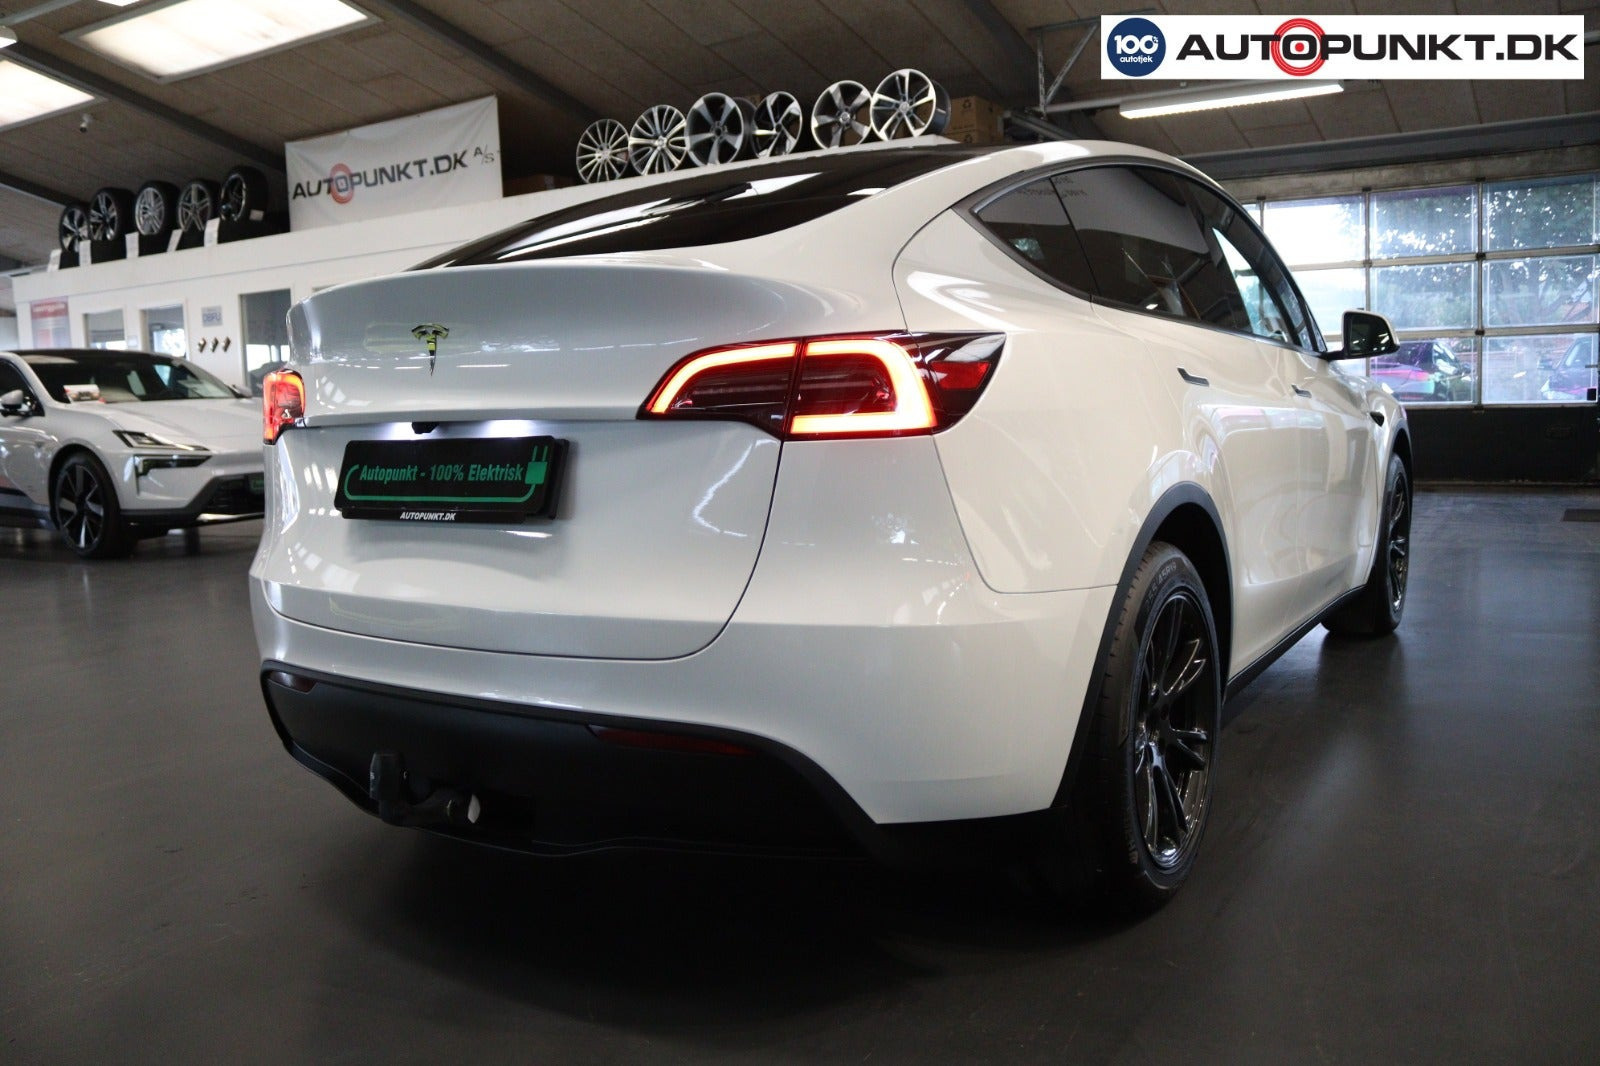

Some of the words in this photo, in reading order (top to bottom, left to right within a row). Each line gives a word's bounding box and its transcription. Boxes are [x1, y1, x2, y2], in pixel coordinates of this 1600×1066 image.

[292, 151, 468, 200] AUTOPUNKT.DK
[359, 464, 418, 485] Autopunkt
[430, 463, 464, 481] 100%
[467, 462, 523, 482] Elektrisk
[400, 511, 456, 521] AUTOPUNKT.DK
